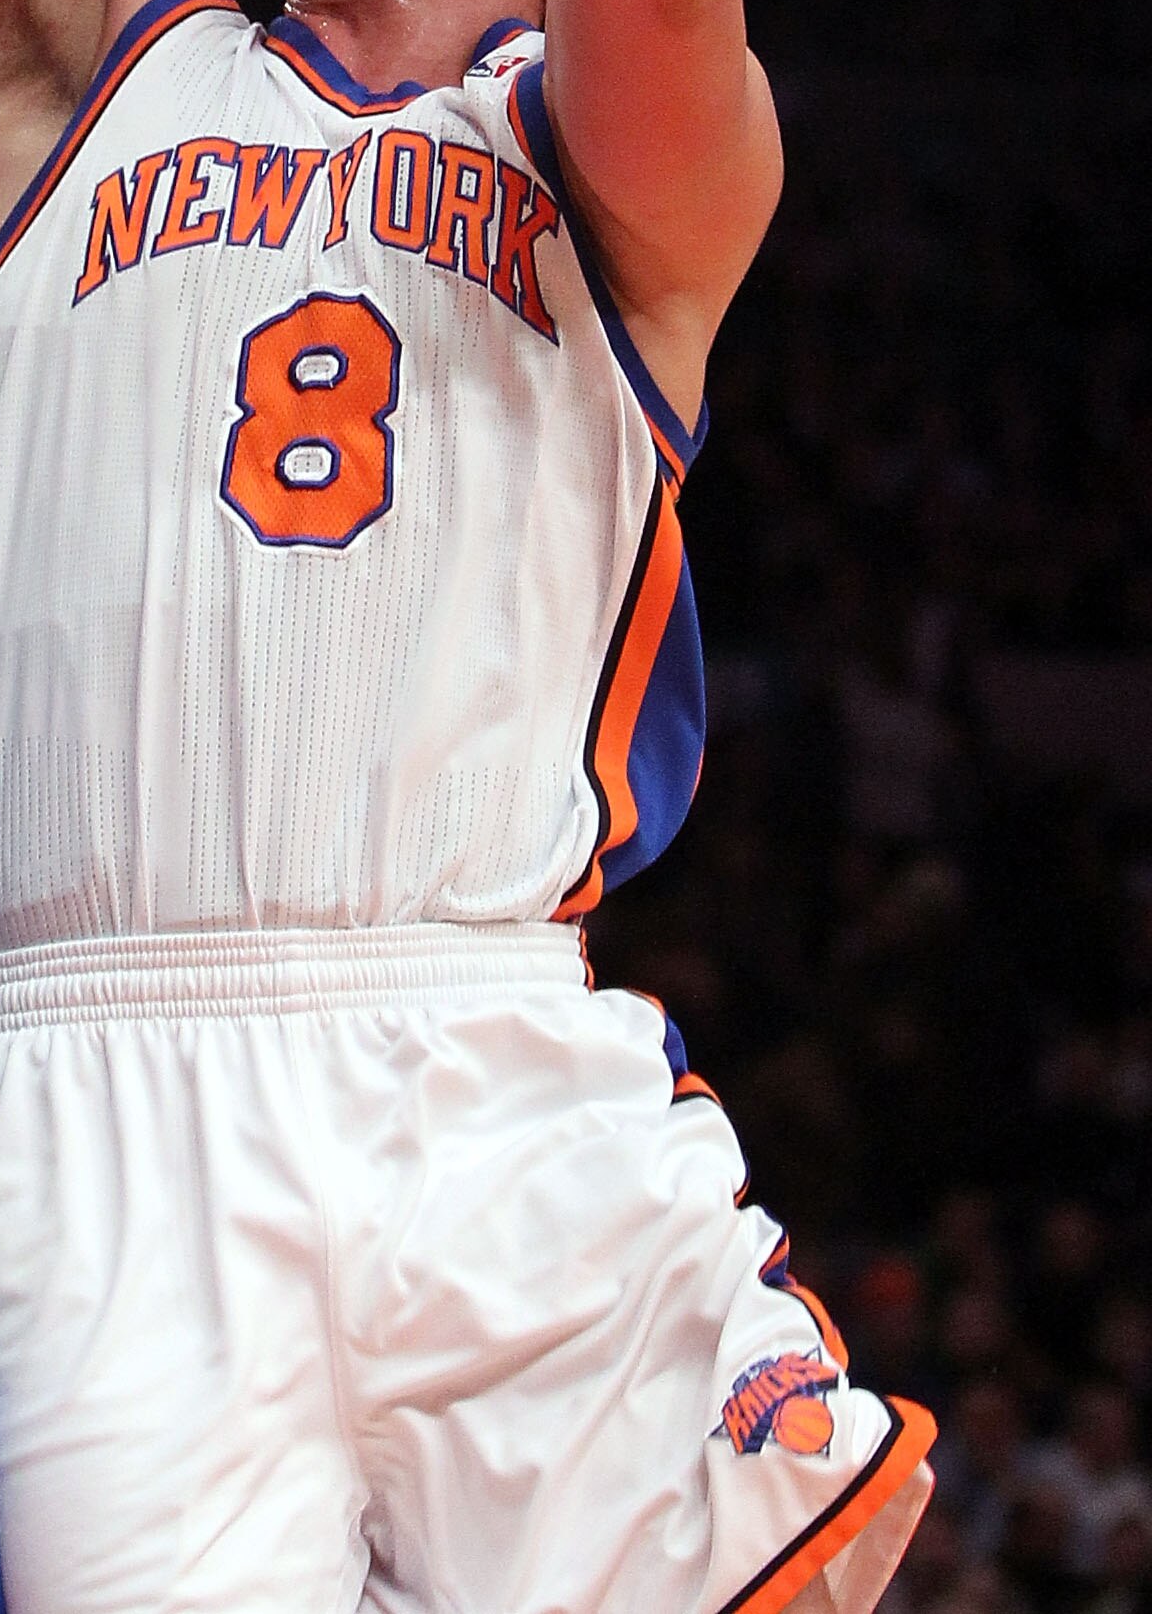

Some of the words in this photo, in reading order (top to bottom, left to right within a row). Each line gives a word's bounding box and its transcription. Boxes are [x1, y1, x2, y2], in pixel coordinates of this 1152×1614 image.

[71, 136, 330, 308] NEW
[322, 127, 562, 348] YORK
[220, 291, 403, 549] 8
